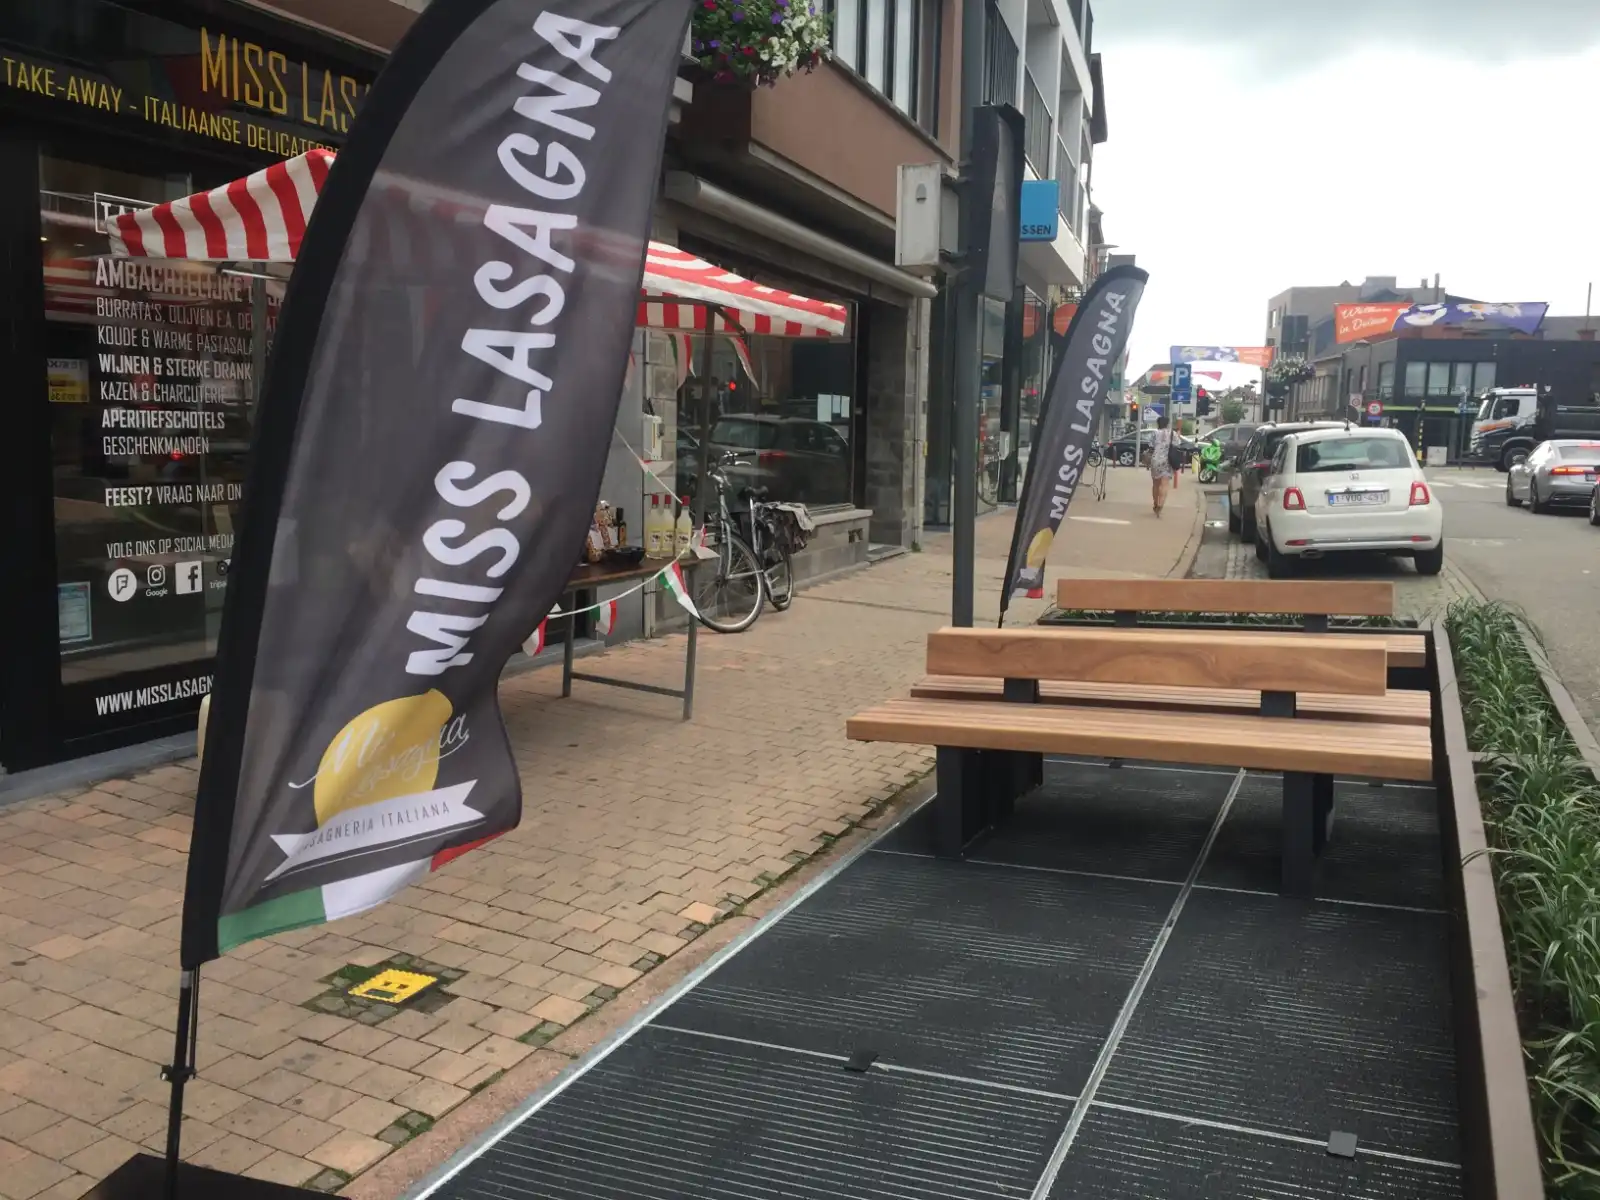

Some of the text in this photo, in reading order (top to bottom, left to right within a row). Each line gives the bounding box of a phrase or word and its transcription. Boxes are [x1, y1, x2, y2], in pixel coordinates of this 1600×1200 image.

[201, 27, 369, 134] MISS LAS
[4, 57, 122, 114] TAKE-AWAY
[144, 95, 241, 144] ITALIAANSE
[169, 304, 214, 327] OLIJVEN
[97, 324, 138, 347] KOUDE
[140, 328, 150, 348] &
[152, 330, 193, 351] WARME
[404, 10, 622, 676] MISS LASAGNA
[98, 353, 150, 376] WIJNEN
[153, 357, 162, 376] &
[166, 357, 211, 379] STERKE
[1175, 367, 1189, 386] P
[100, 381, 138, 401] KAZEN
[141, 382, 149, 401] &
[1049, 290, 1127, 521] MISS LASAGNA
[102, 408, 226, 429] APERITIEFSCHOTELS
[102, 436, 210, 456] GESCHENKMANDEN
[105, 486, 153, 507] FEEST?
[156, 484, 193, 505] VRAAG
[196, 483, 225, 502] NAAR
[106, 541, 133, 559] VOLG
[135, 539, 156, 557] ONS
[158, 538, 172, 554] OP
[174, 535, 207, 553] SOCIAL
[145, 587, 169, 598] Google
[380, 801, 451, 828] ITALIANA
